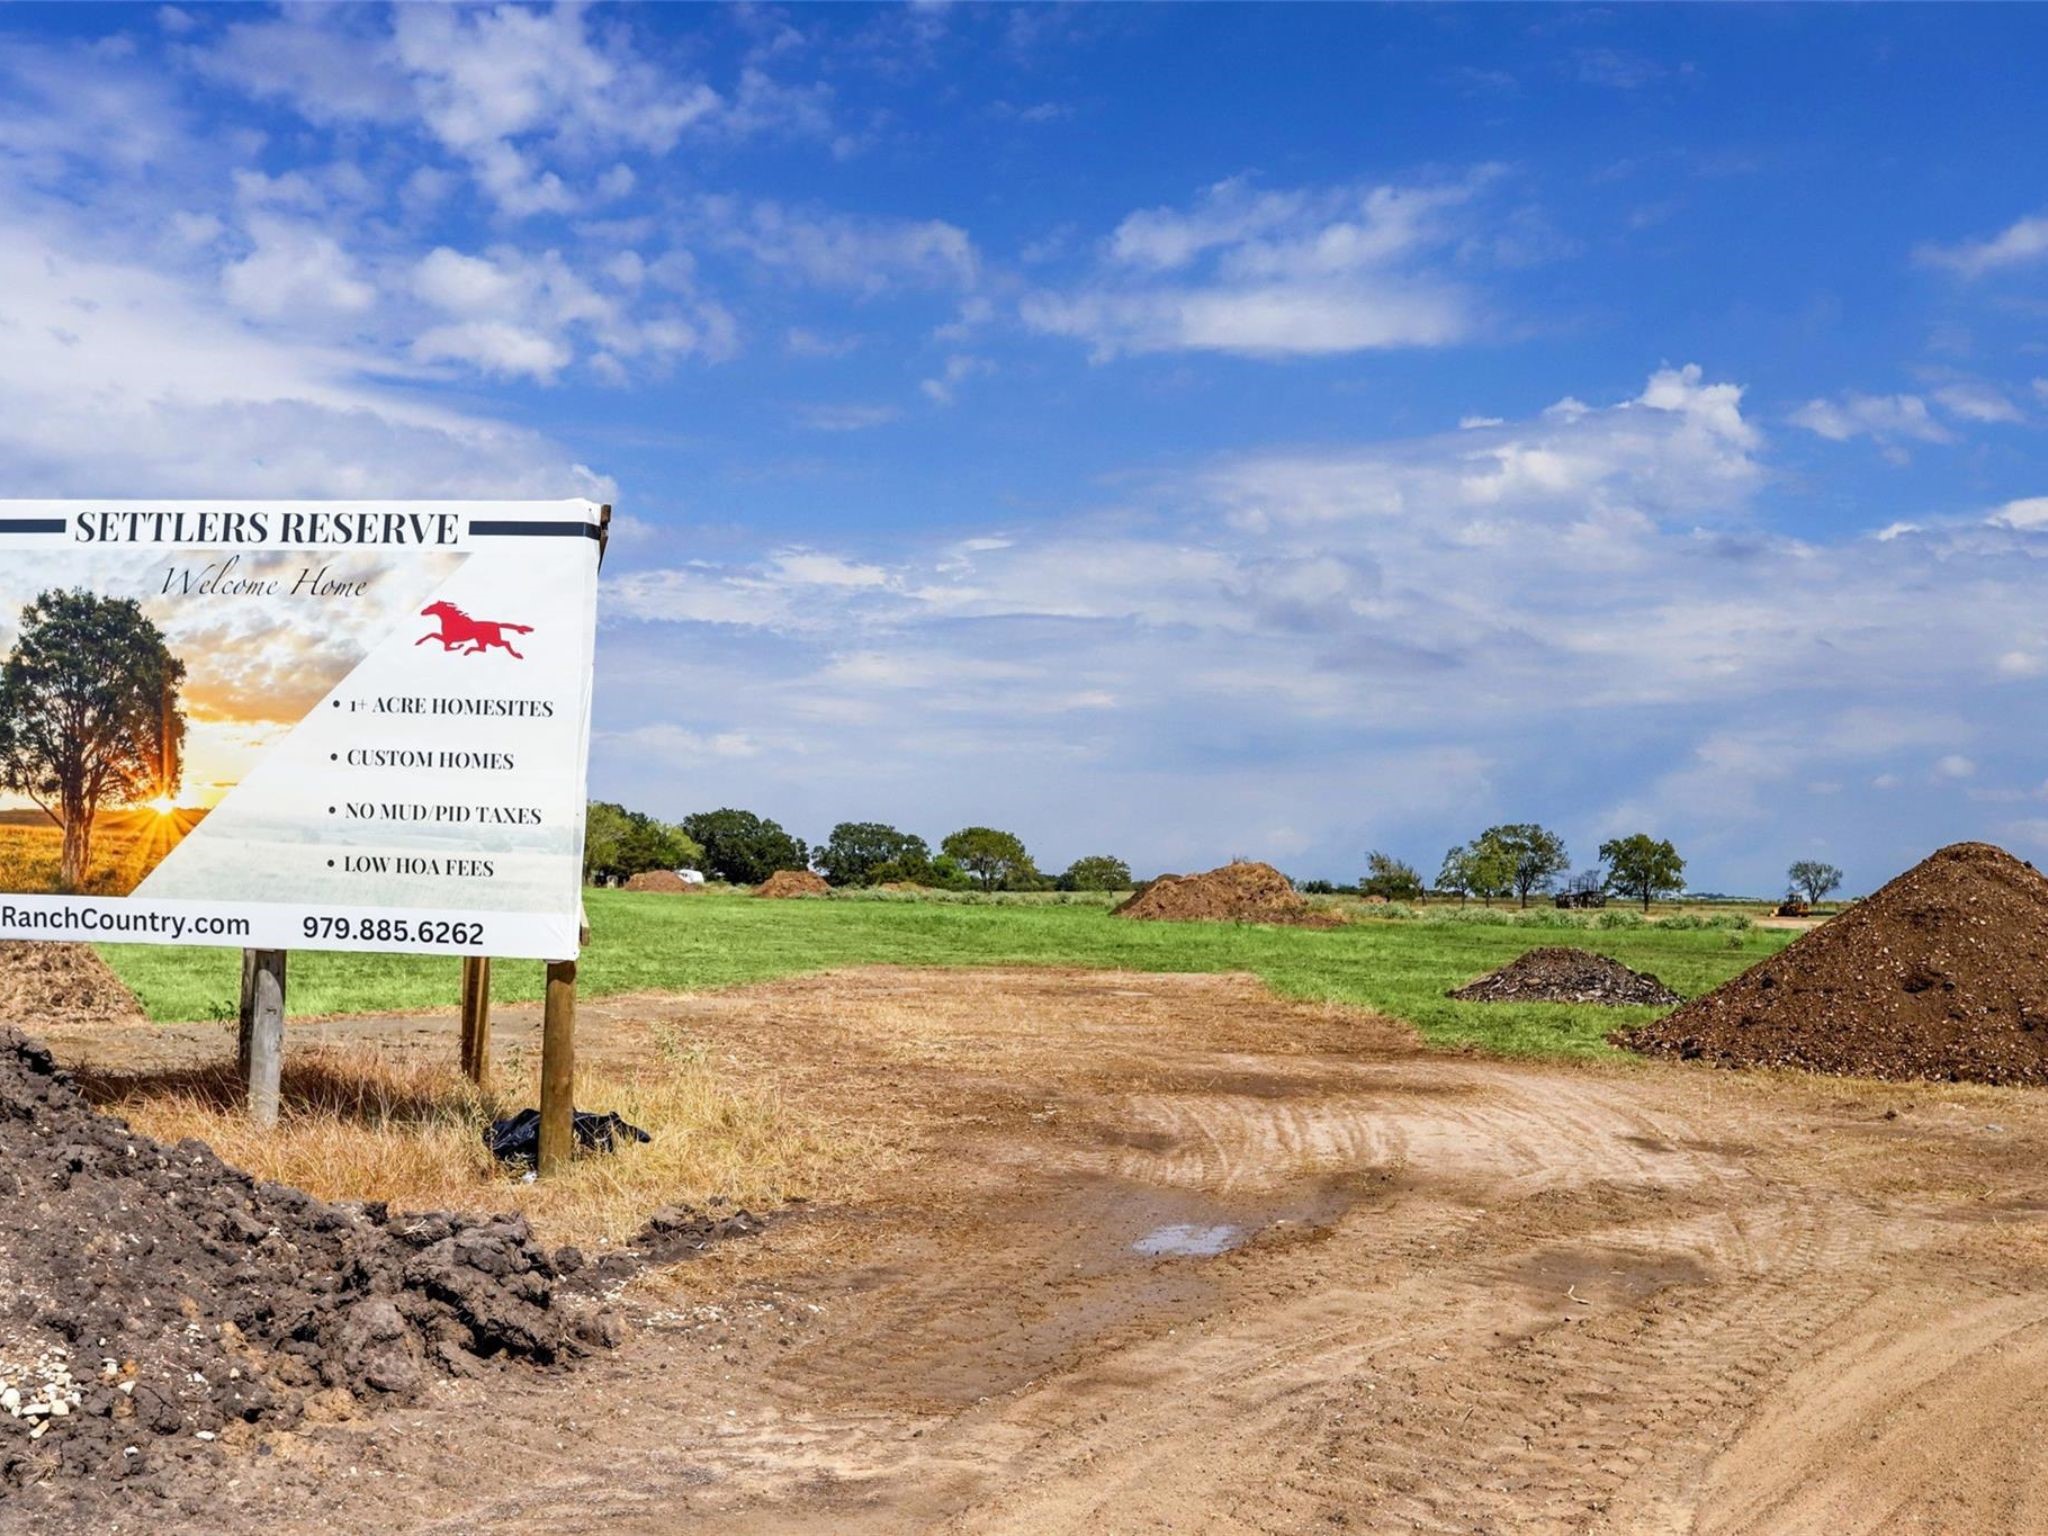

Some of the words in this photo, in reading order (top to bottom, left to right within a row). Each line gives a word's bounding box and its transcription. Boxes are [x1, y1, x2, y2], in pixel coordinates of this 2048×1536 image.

[75, 511, 269, 544] SETTLERS
[279, 512, 460, 545] RESERVE
[160, 554, 281, 597] Welcome
[289, 566, 369, 598] Home
[350, 698, 369, 714] 1+
[372, 696, 428, 715] ACRE
[431, 697, 554, 718] HOMESITES
[347, 750, 433, 768] CUSTOM
[438, 751, 514, 770] HOMES
[344, 802, 375, 821] NO
[379, 803, 471, 823] MUD/PID
[475, 805, 542, 825] TAXES
[343, 855, 391, 875] LOW
[396, 857, 440, 875] HOA
[444, 858, 494, 877] FEES
[2, 905, 250, 938] RanchCountry.com
[302, 916, 484, 945] 979.885.6262
